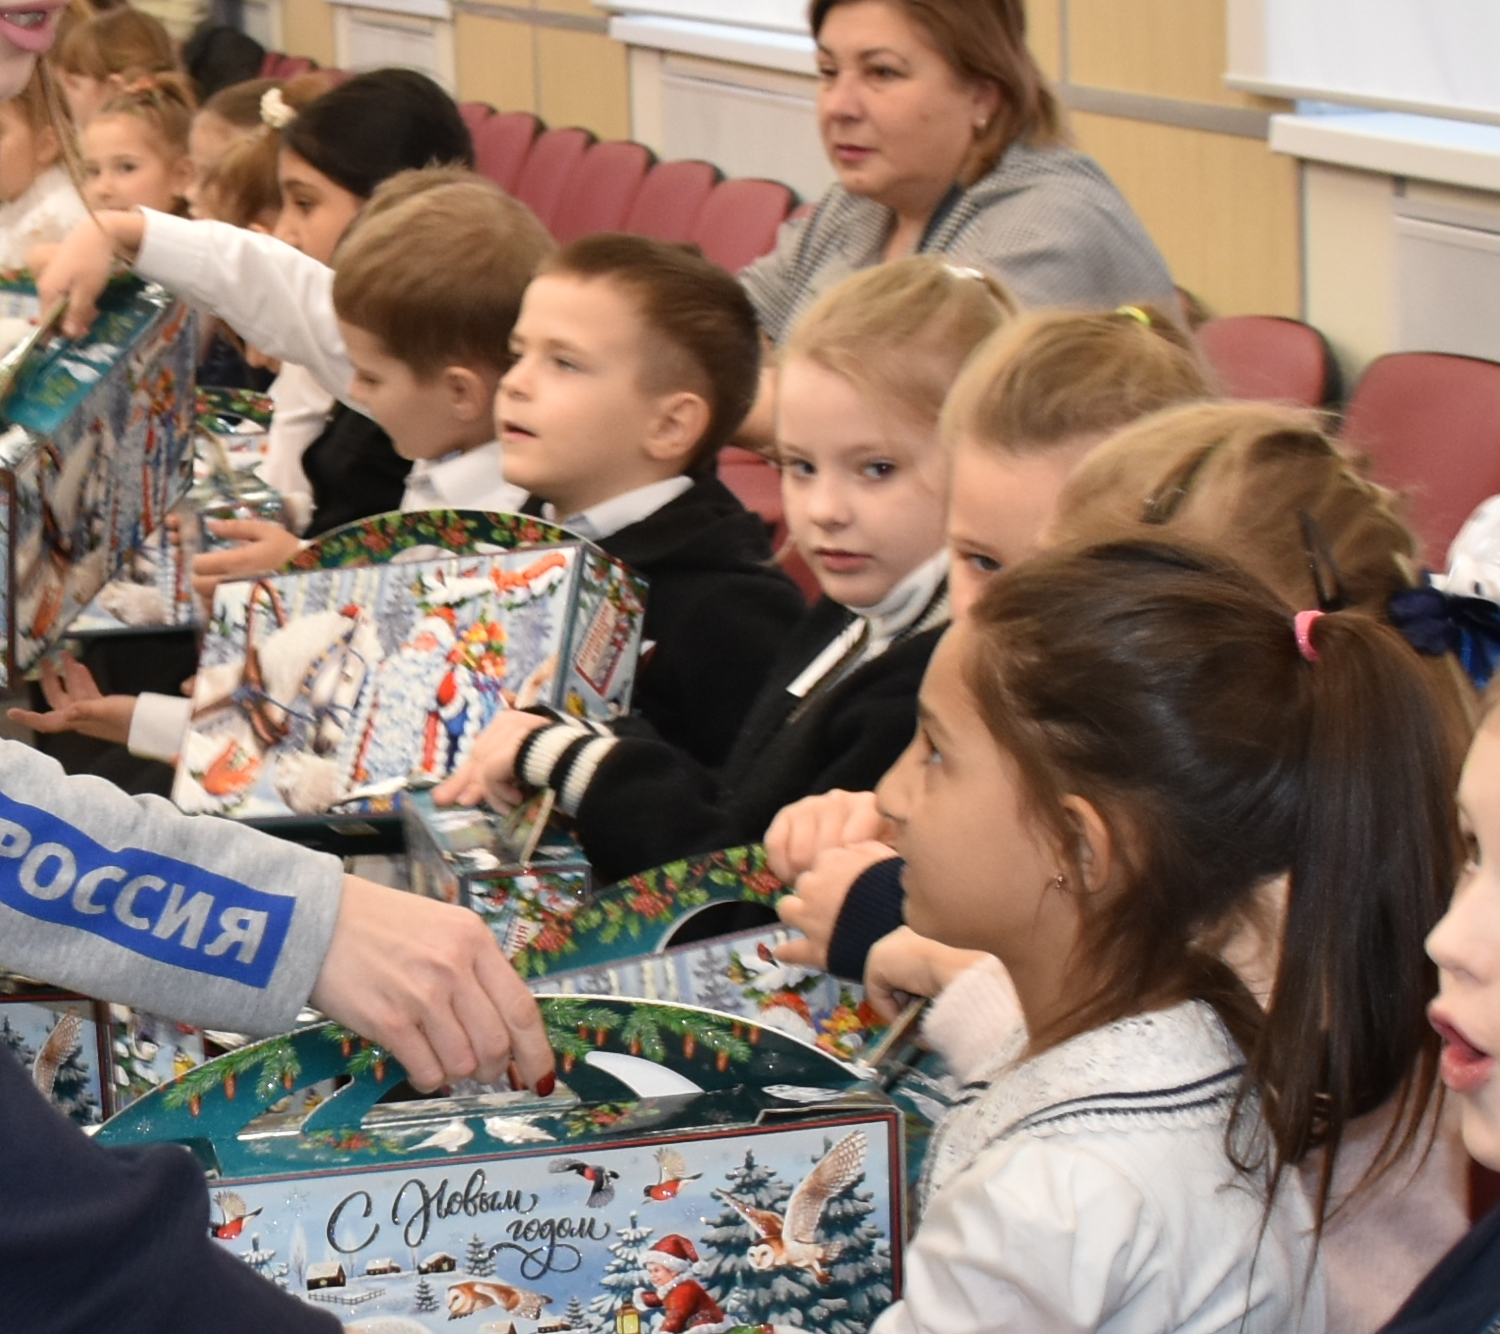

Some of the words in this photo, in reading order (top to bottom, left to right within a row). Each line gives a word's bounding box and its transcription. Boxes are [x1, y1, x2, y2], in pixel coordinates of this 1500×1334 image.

[326, 1190, 380, 1254] С
[391, 1168, 539, 1248] Новым
[488, 1216, 611, 1281] годом
